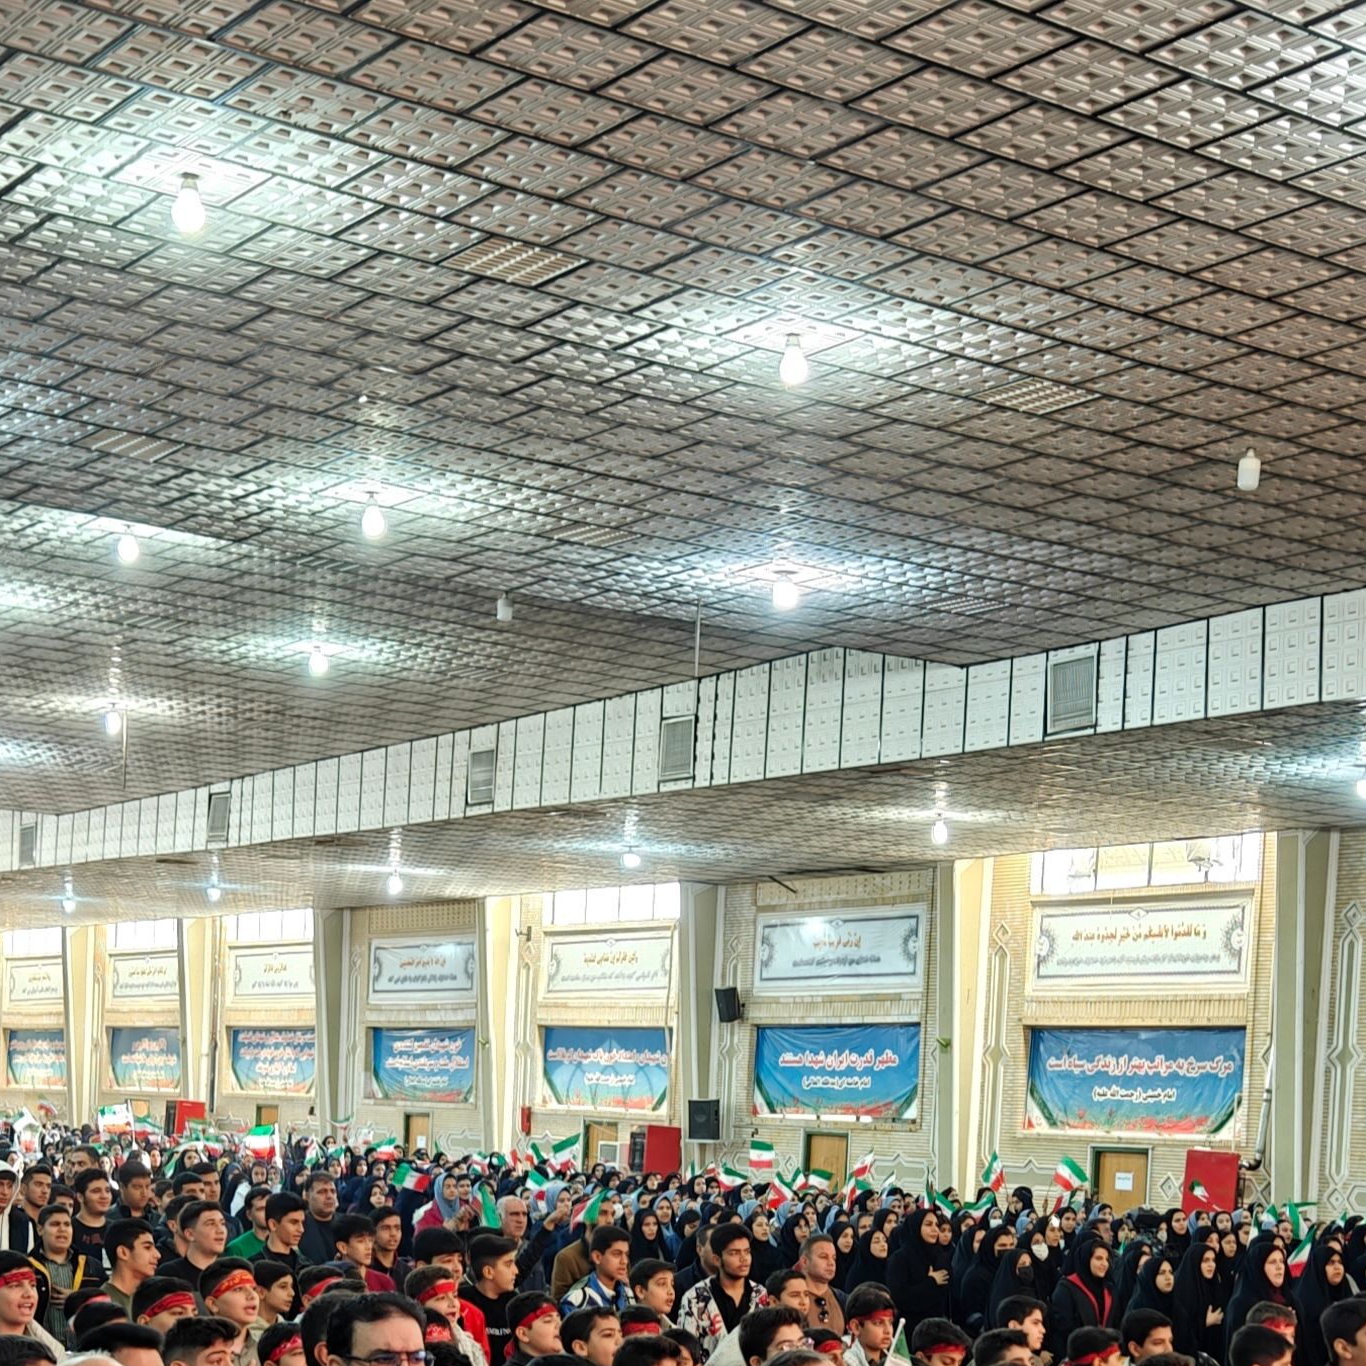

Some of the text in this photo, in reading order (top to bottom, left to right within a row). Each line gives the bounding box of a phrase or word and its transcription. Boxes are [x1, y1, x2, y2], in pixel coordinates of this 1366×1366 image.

[1087, 1057, 1117, 1075] زندگی
[1129, 1059, 1146, 1075] بهتر
[1147, 1057, 1174, 1075] مراتب
[1174, 1062, 1185, 1076] به
[1186, 1059, 1208, 1076] سرخ
[1209, 1057, 1234, 1075] مرگ
